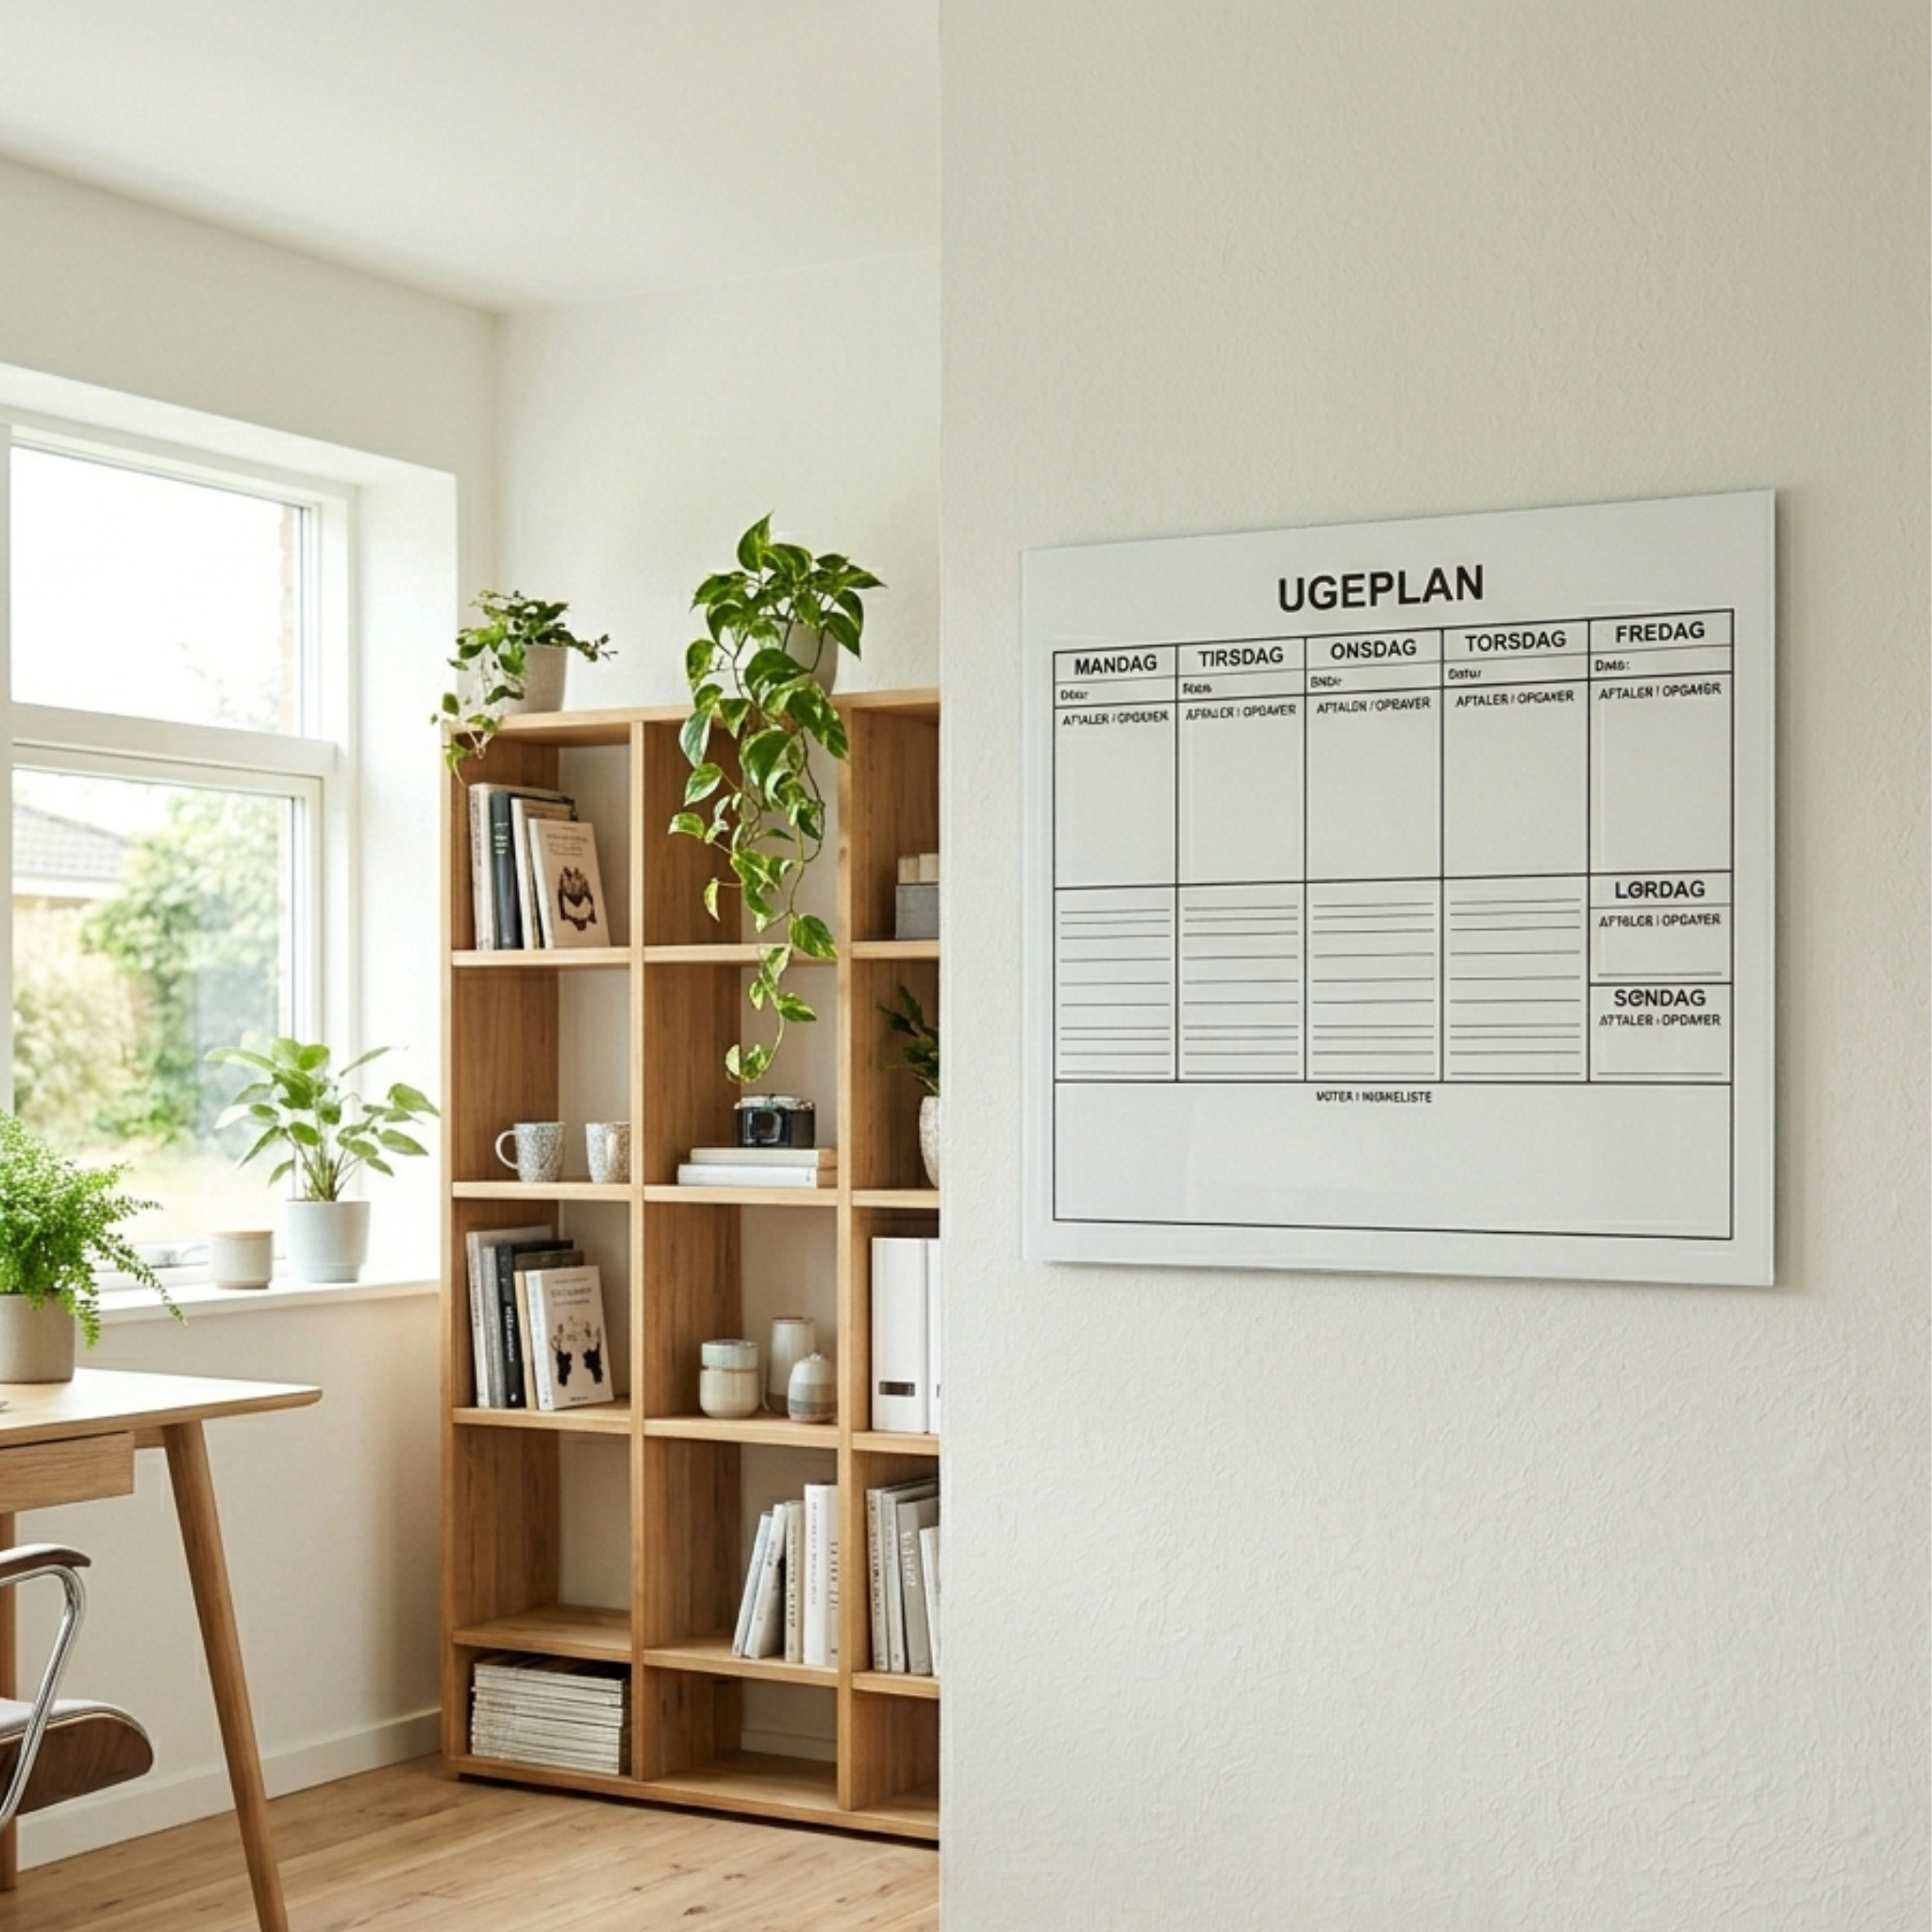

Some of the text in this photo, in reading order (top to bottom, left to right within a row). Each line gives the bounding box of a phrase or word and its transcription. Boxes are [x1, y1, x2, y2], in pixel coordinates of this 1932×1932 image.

[1277, 563, 1484, 613] UGEPLAN
[1465, 630, 1567, 652] TORSDAG
[1615, 621, 1706, 643] FREDAG
[1196, 645, 1285, 668] TIRSDAG
[1330, 639, 1417, 660] ONSDAG
[1074, 654, 1158, 675] MANDAG
